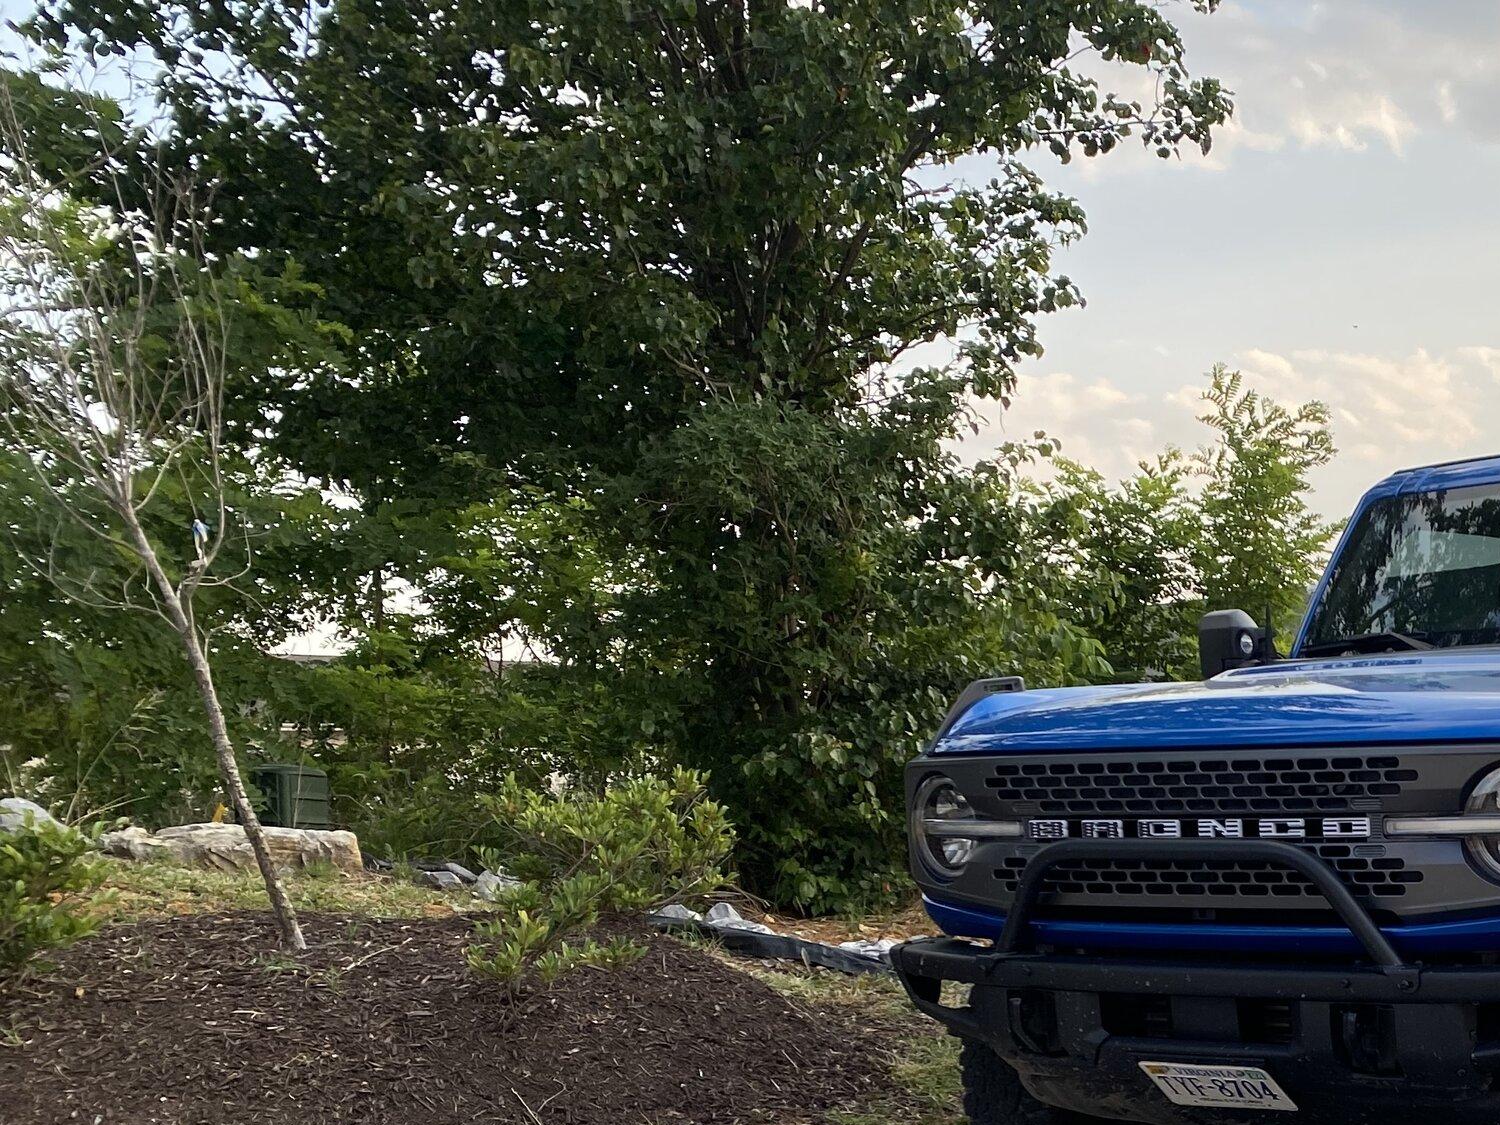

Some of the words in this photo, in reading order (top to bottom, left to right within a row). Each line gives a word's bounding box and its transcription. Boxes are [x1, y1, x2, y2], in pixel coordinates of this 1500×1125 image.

[1028, 817, 1372, 838] BRONCO
[1173, 1066, 1238, 1079] VIRGINIA
[1157, 1075, 1281, 1100] TYF-8704
